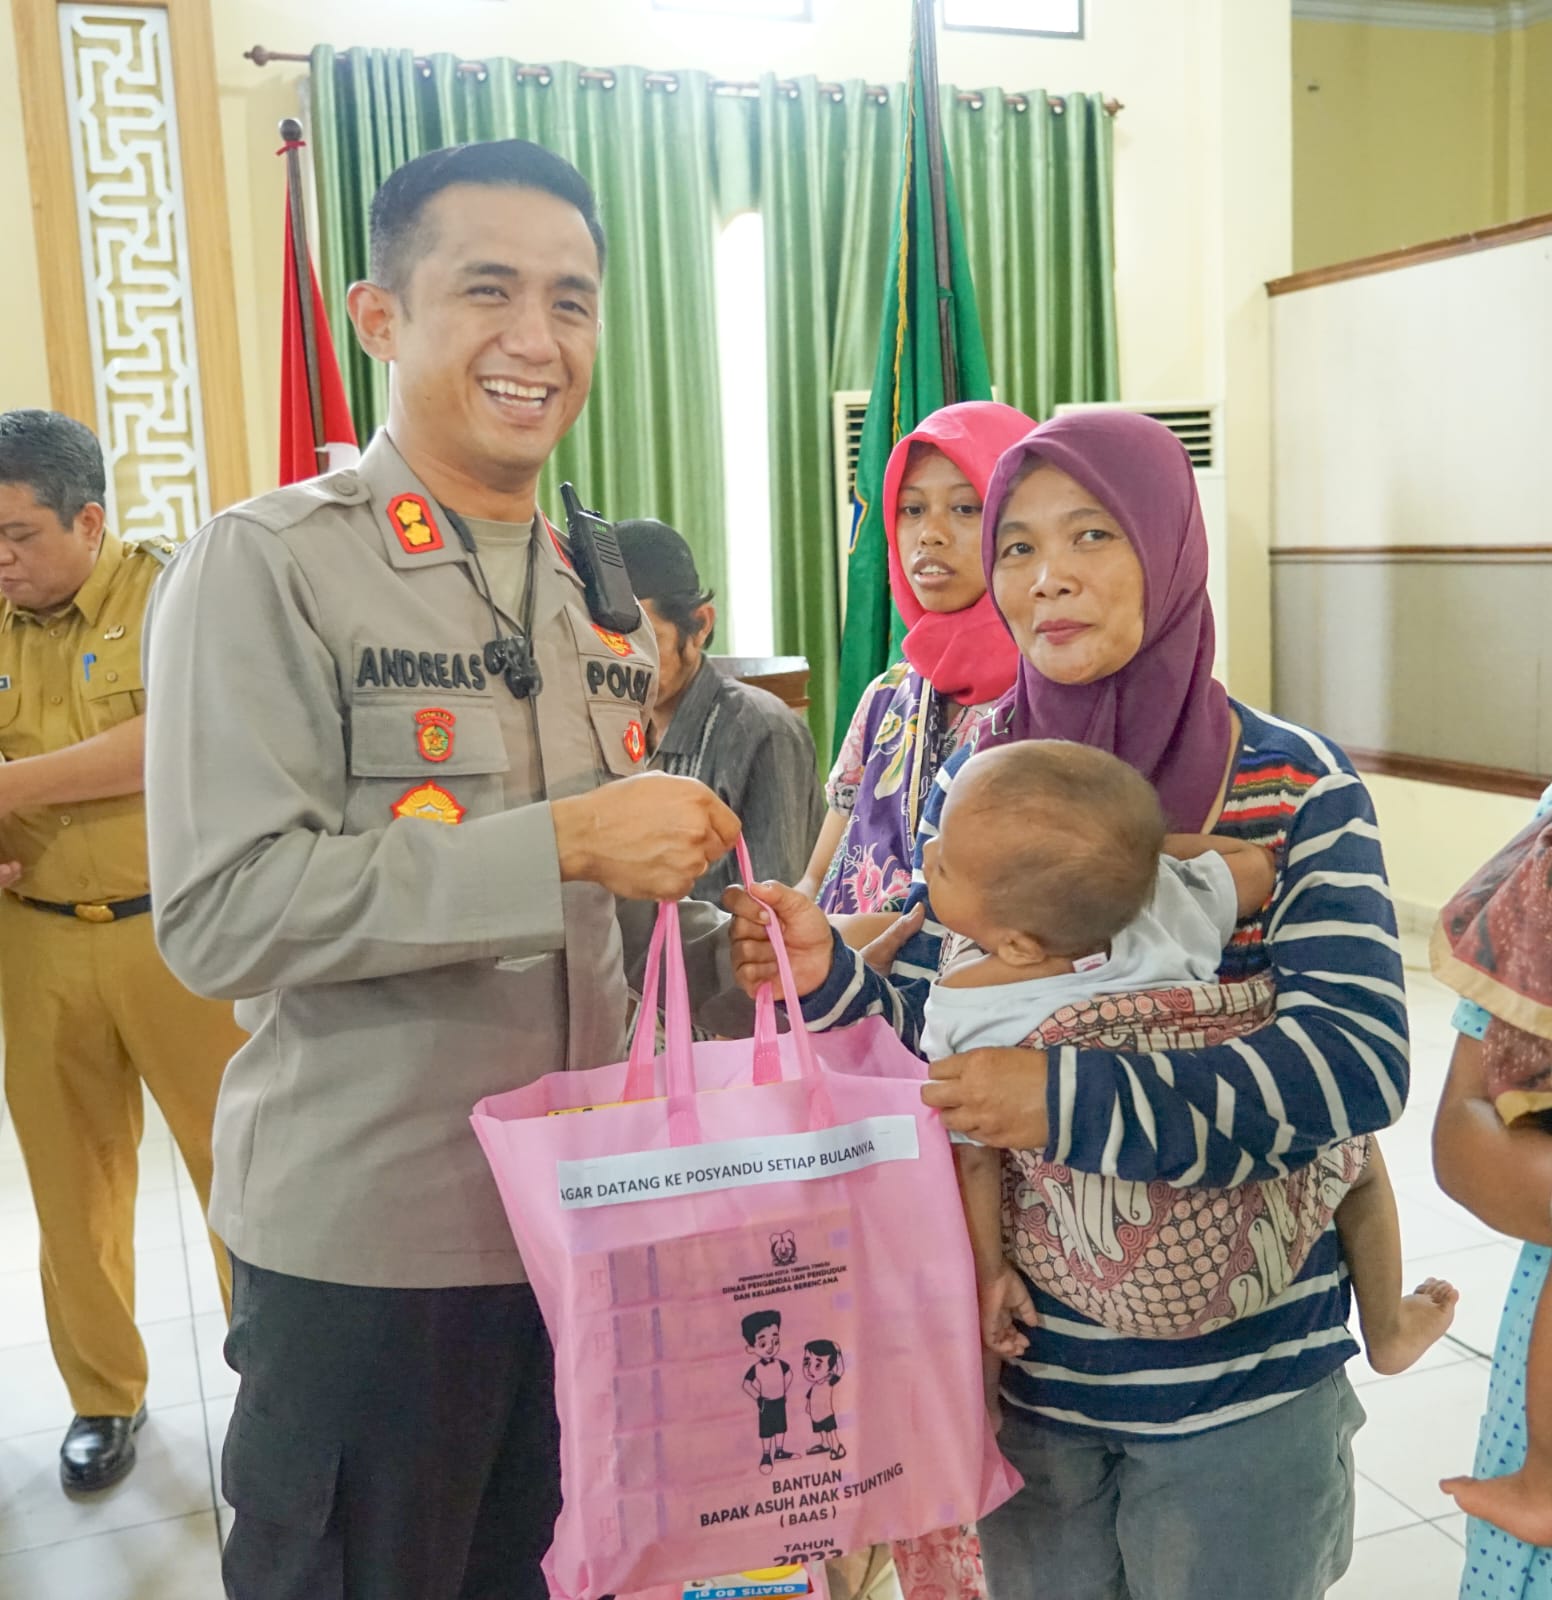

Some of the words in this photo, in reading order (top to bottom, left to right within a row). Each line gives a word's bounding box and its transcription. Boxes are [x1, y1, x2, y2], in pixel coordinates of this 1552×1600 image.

[356, 647, 487, 691] ANDREAS
[597, 1176, 660, 1197] DATANG
[665, 1173, 682, 1187] KE
[686, 1161, 763, 1184] POSYANDU
[767, 1156, 816, 1172] SETIAP
[820, 1140, 875, 1166] BULANNYA
[722, 1284, 746, 1294] DINAS
[747, 1274, 806, 1290] PENGENDALIAN
[807, 1265, 847, 1278] PENDUDUK
[733, 1292, 751, 1301] DAN
[751, 1285, 792, 1298] KELUARGA
[793, 1276, 839, 1290] BERENCANA
[700, 1505, 750, 1527] BAPAK
[754, 1496, 795, 1516] ASUH
[798, 1487, 840, 1507] ANAK
[843, 1462, 904, 1499] STUNTING
[772, 1469, 843, 1495] BANTUAN
[784, 1537, 835, 1553] TAHUN
[741, 1585, 796, 1595] GRATIS
